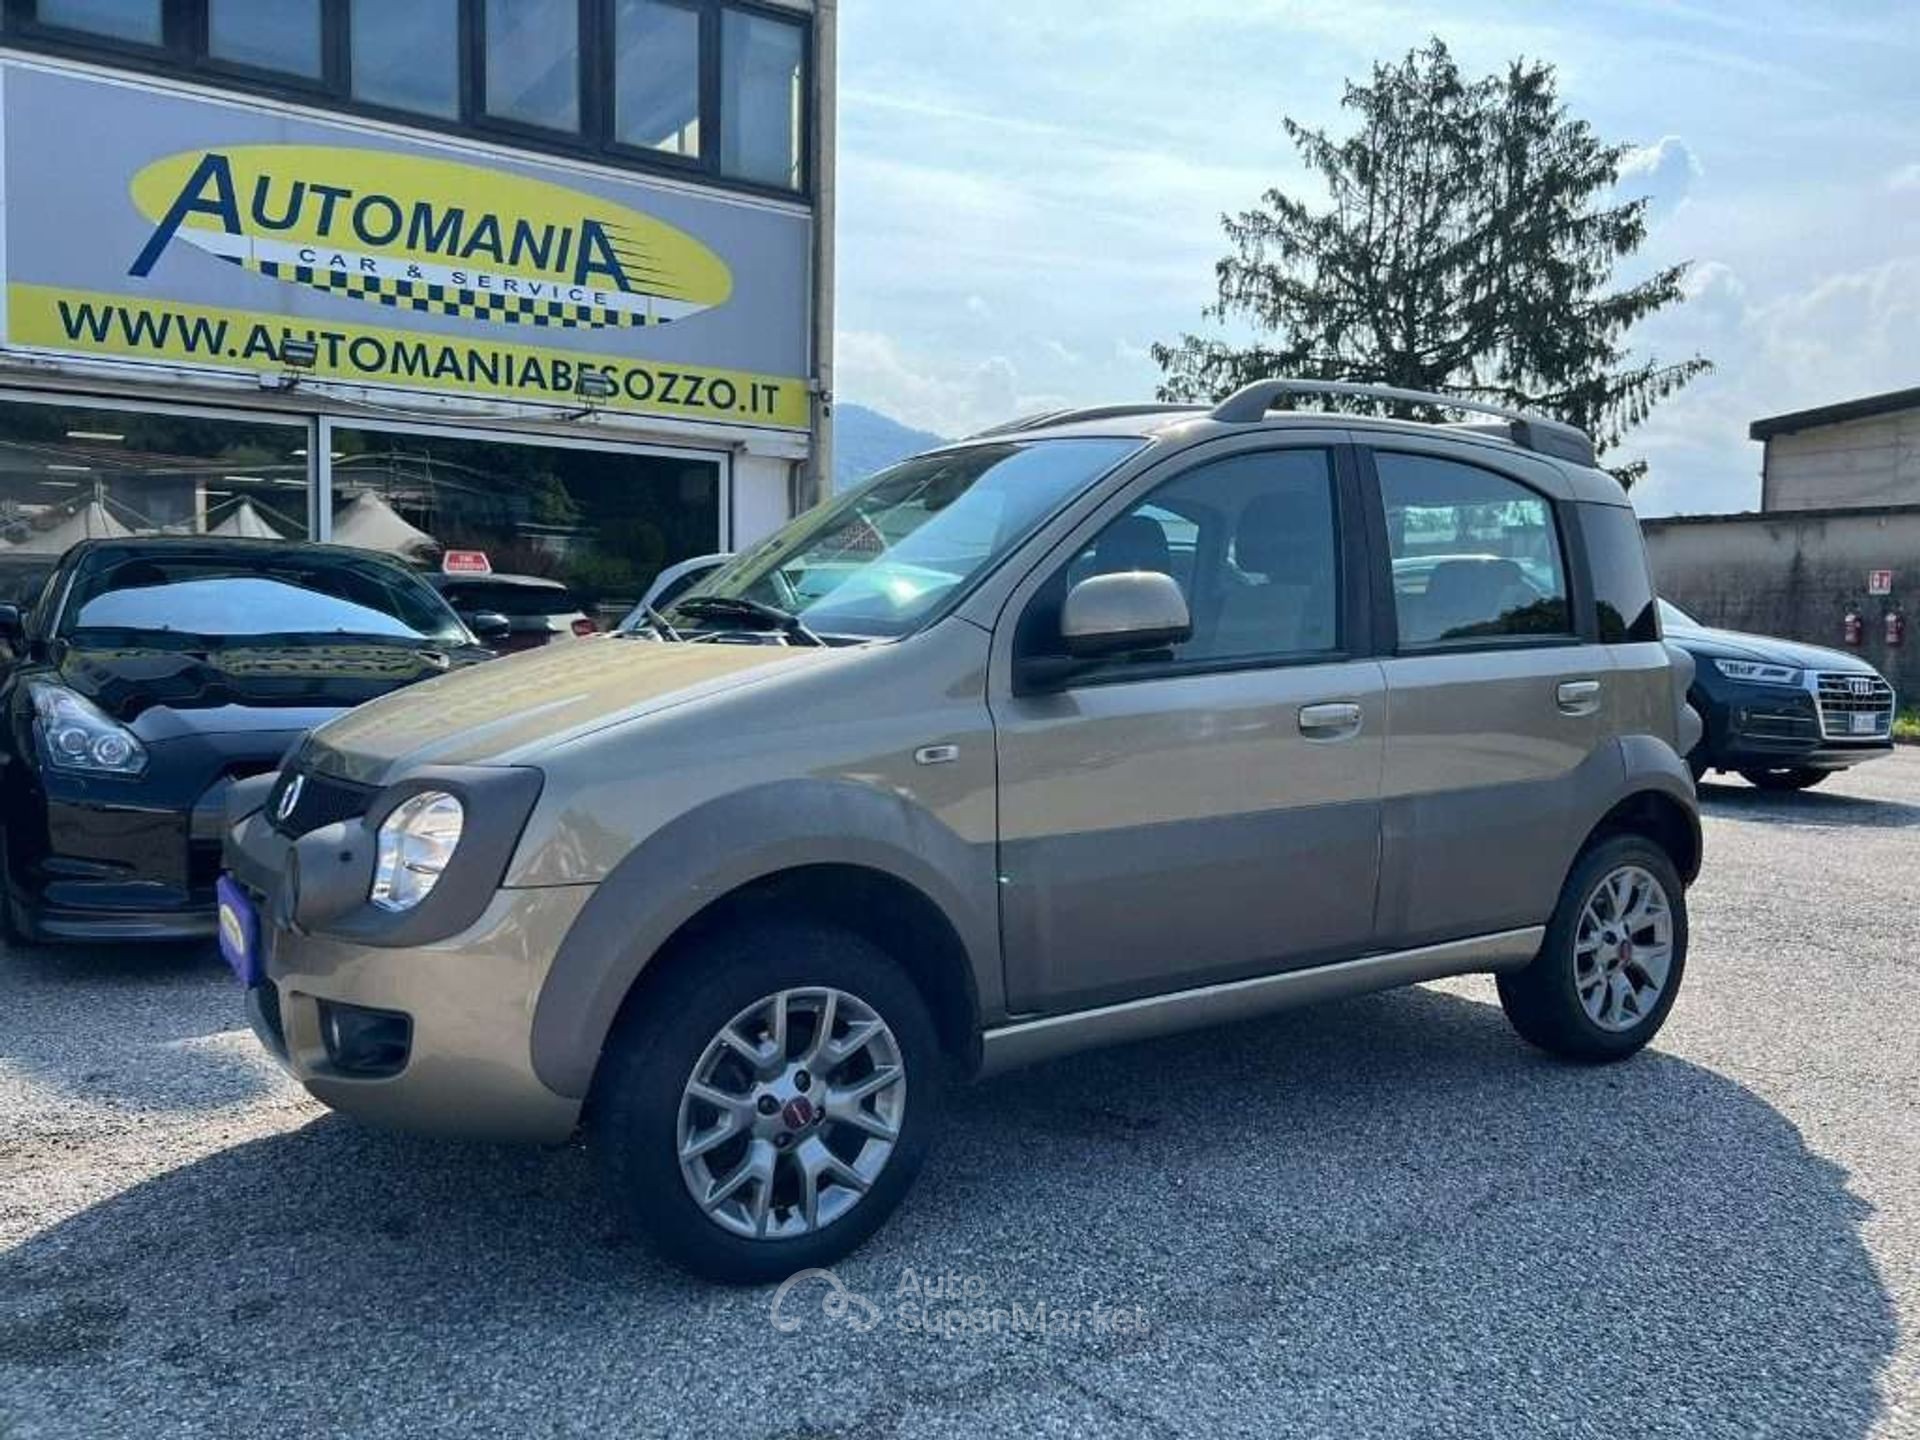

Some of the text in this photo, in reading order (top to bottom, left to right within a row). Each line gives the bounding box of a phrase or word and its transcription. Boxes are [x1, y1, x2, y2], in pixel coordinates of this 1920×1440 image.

[128, 153, 631, 292] AUTOMANIA
[299, 249, 607, 305] CAR & SERVICE
